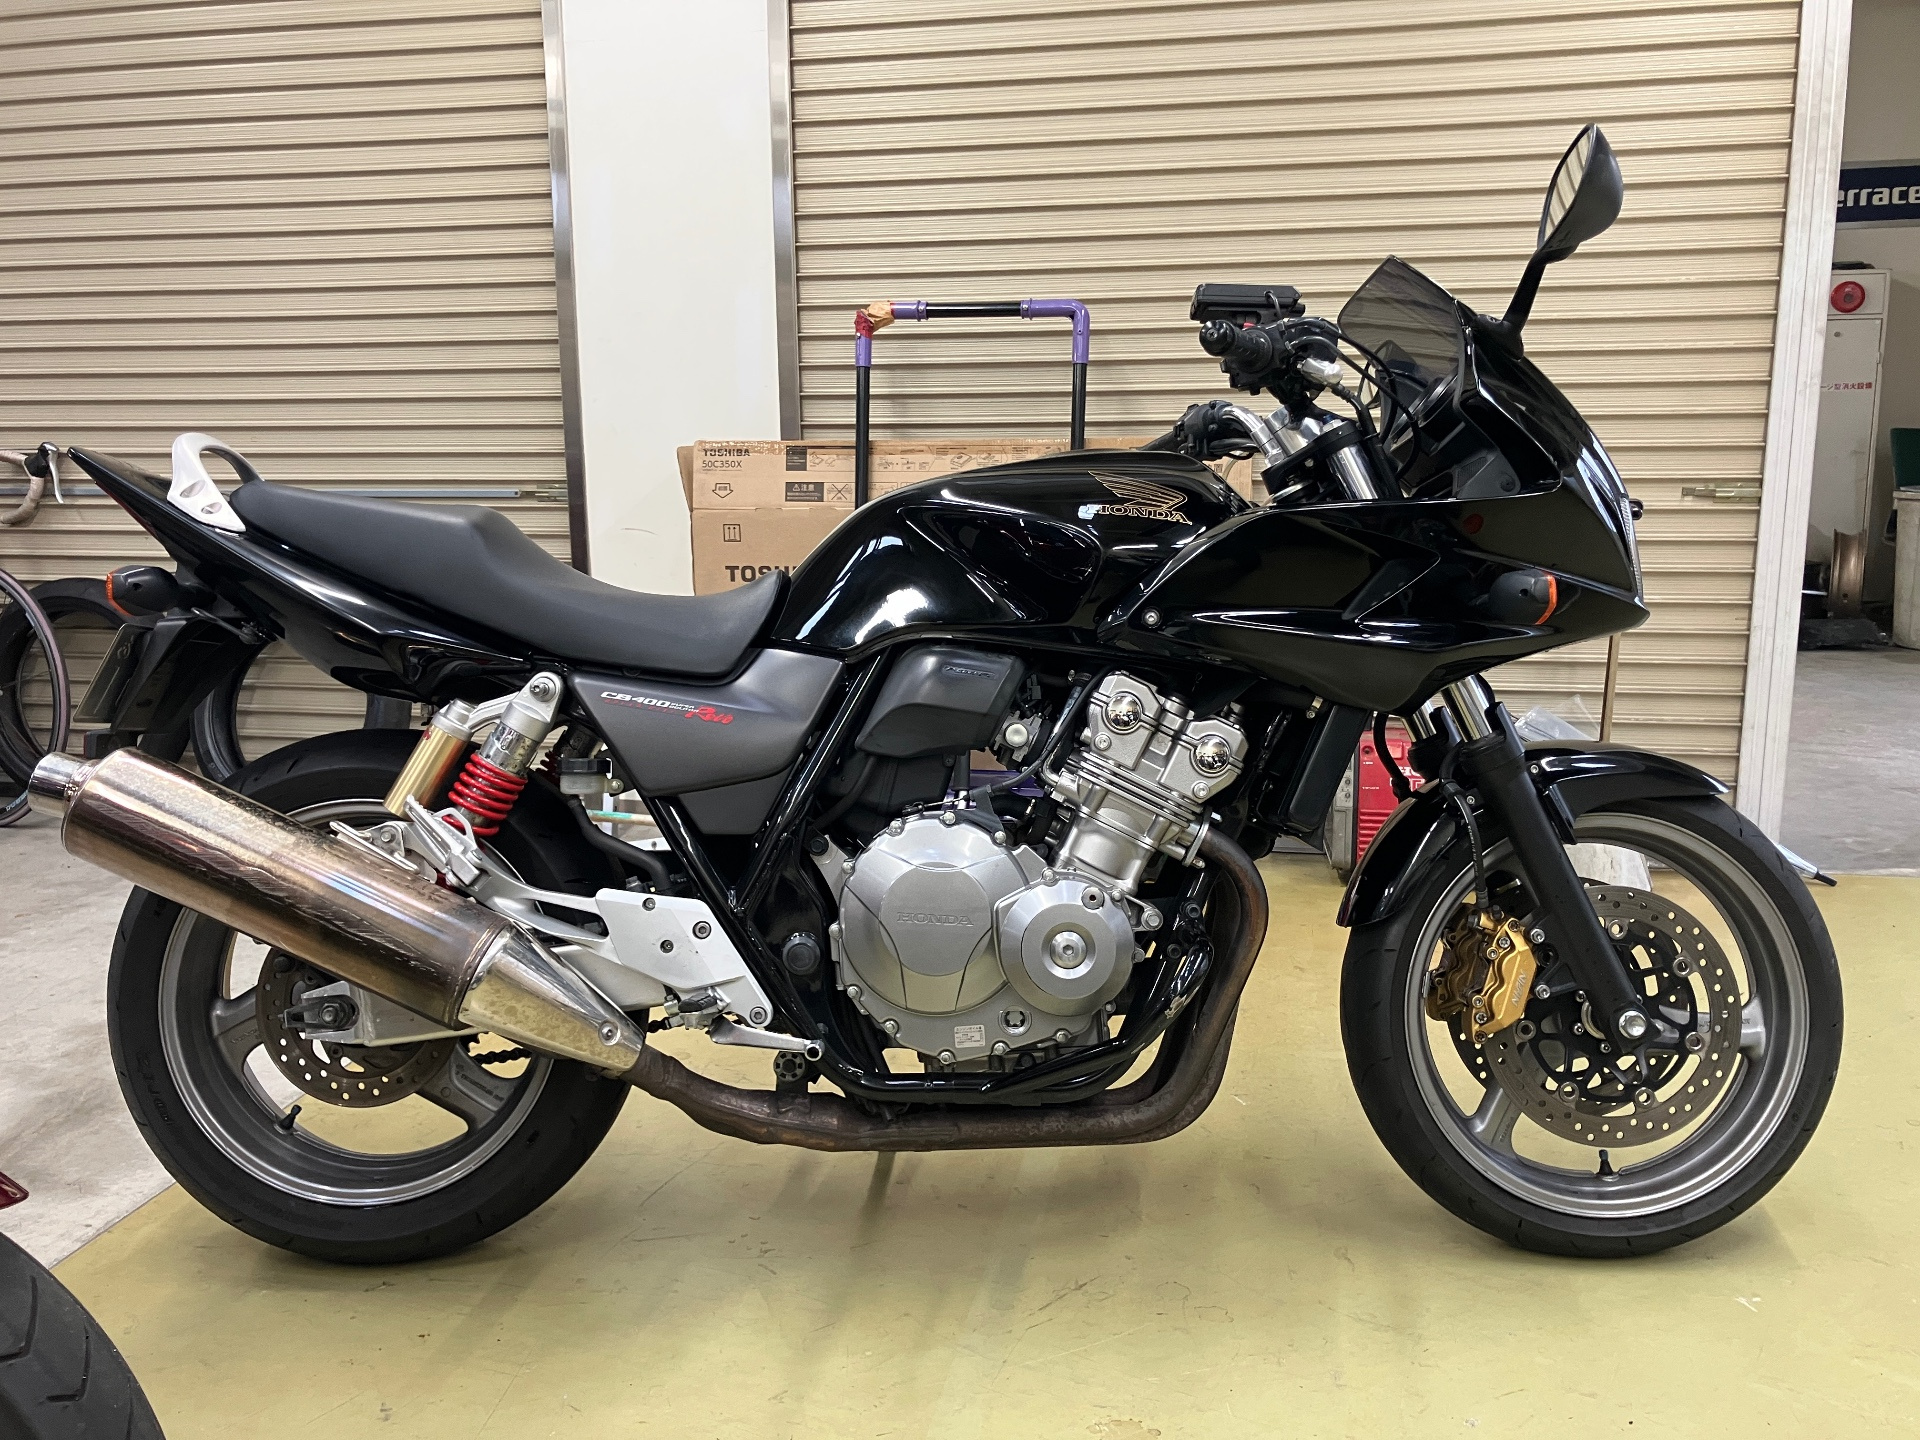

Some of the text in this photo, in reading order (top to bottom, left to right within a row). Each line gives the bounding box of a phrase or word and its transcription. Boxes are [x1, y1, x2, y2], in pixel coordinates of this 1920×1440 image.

[703, 448, 750, 457] TOSHIBA
[702, 460, 742, 469] 50C350X
[601, 692, 670, 707] CB400
[896, 911, 975, 927] HONDA
